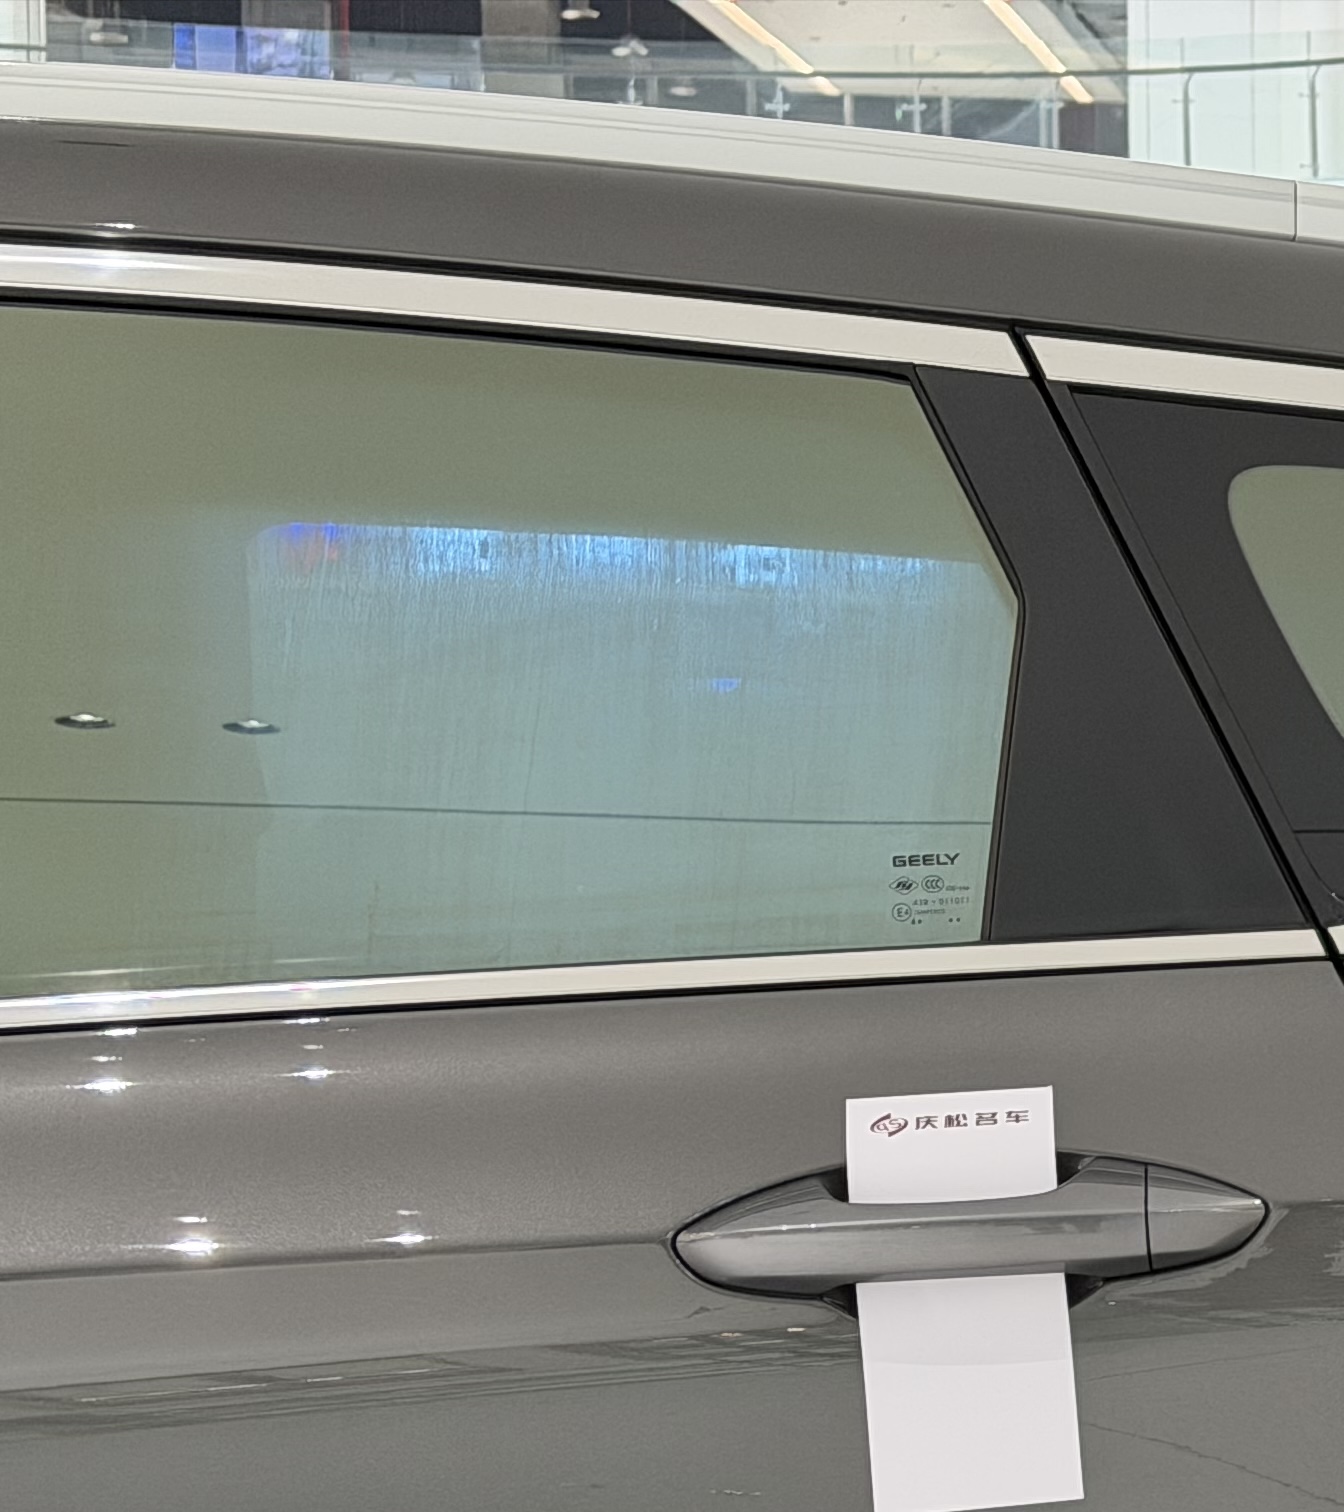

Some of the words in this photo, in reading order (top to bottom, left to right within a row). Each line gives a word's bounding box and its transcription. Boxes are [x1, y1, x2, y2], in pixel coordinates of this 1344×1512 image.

[892, 853, 960, 867] GEELY
[915, 1110, 1030, 1130] 庆松名车
